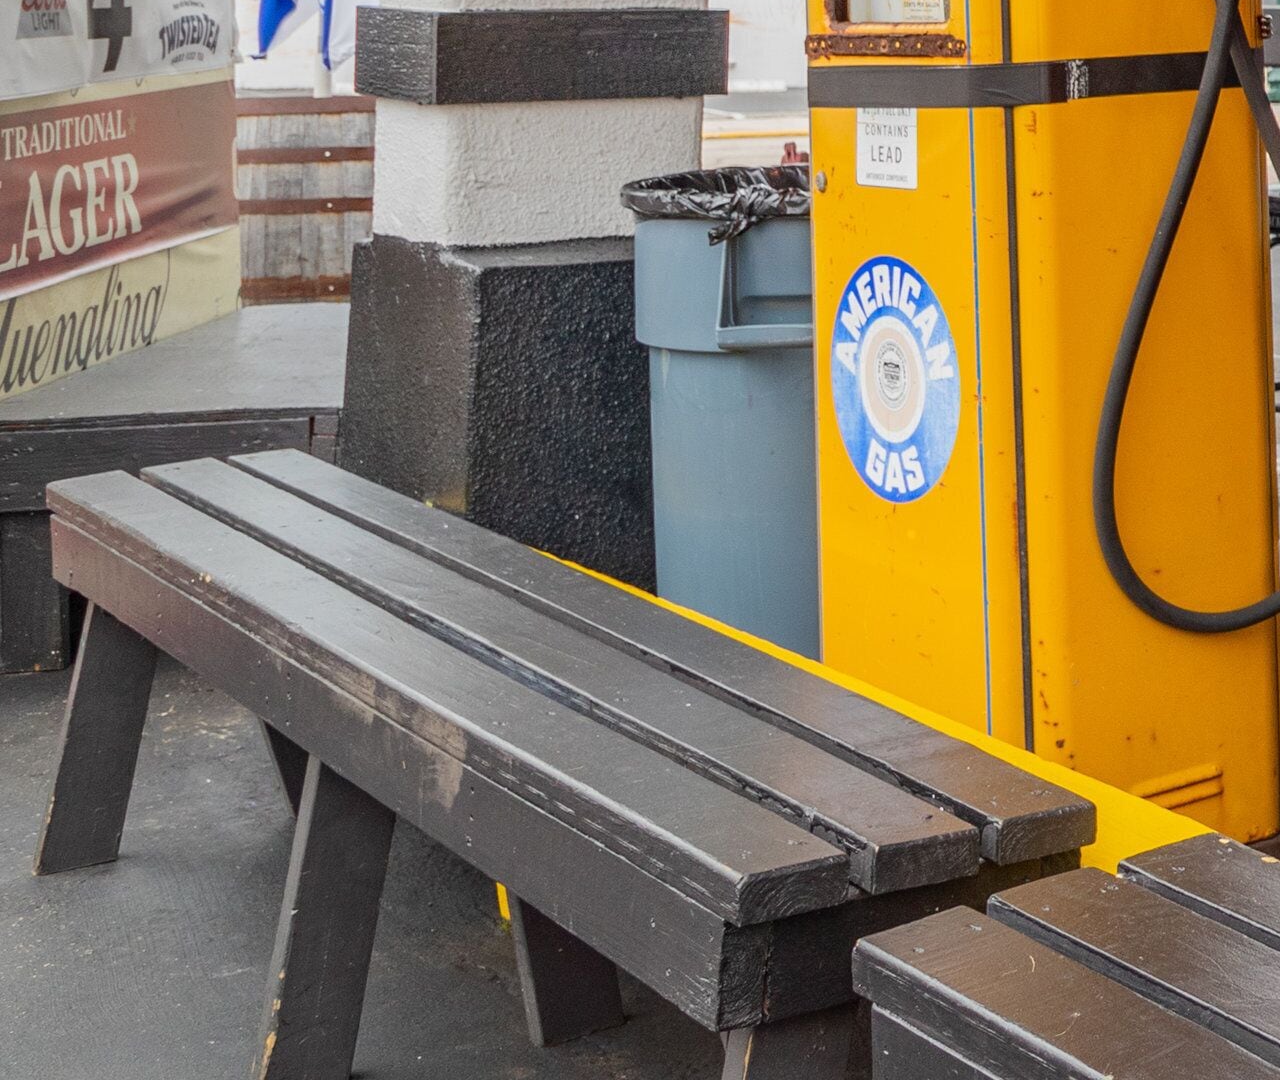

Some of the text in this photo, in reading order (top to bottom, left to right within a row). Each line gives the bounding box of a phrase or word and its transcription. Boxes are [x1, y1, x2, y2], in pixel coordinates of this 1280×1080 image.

[31, 11, 60, 31] LIGHT
[159, 12, 220, 61] TWISTED TEA
[1, 110, 126, 161] TRADITIONAL
[865, 123, 909, 138] CONTAINS
[871, 145, 902, 164] LEAD
[0, 153, 142, 272] AGER
[835, 264, 954, 380] AMERICAN
[865, 438, 925, 494] GAS
